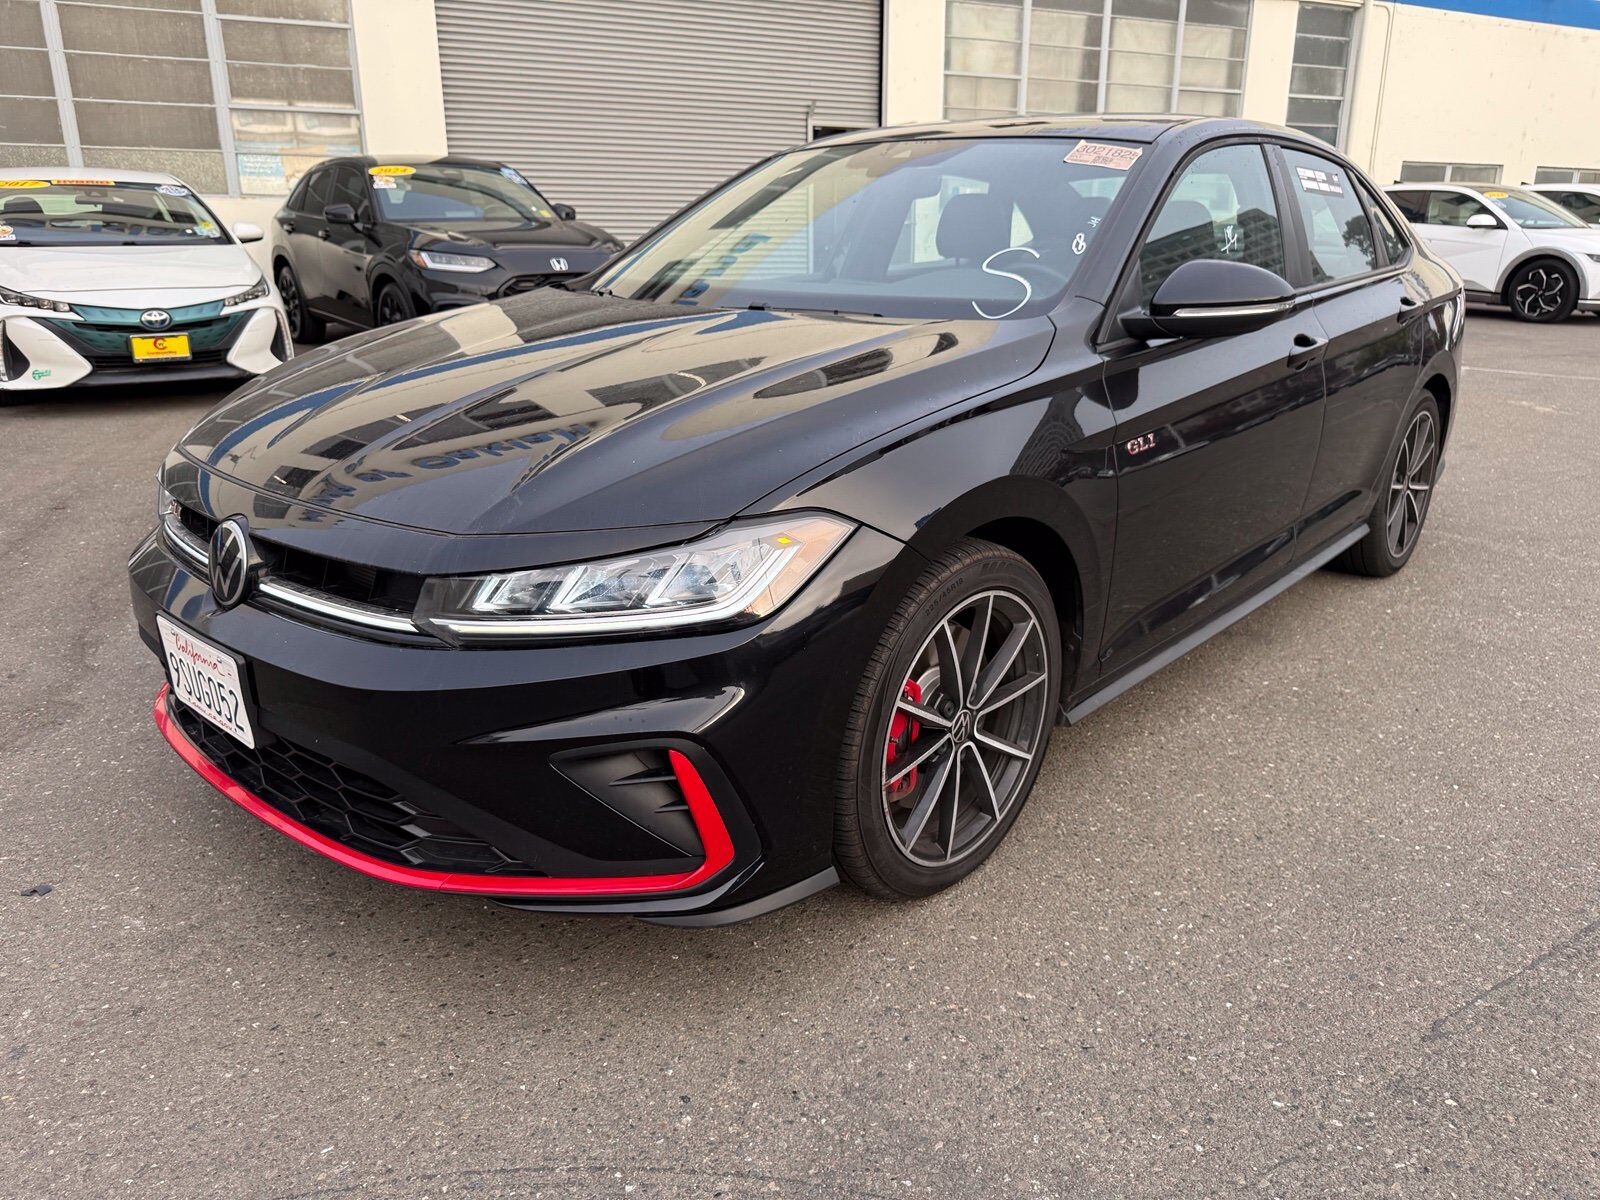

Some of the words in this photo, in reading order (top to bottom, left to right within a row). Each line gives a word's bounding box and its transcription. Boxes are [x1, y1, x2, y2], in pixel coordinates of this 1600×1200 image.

[1127, 433, 1156, 455] GLI
[175, 633, 225, 677] California
[169, 651, 245, 732] 9SUG052
